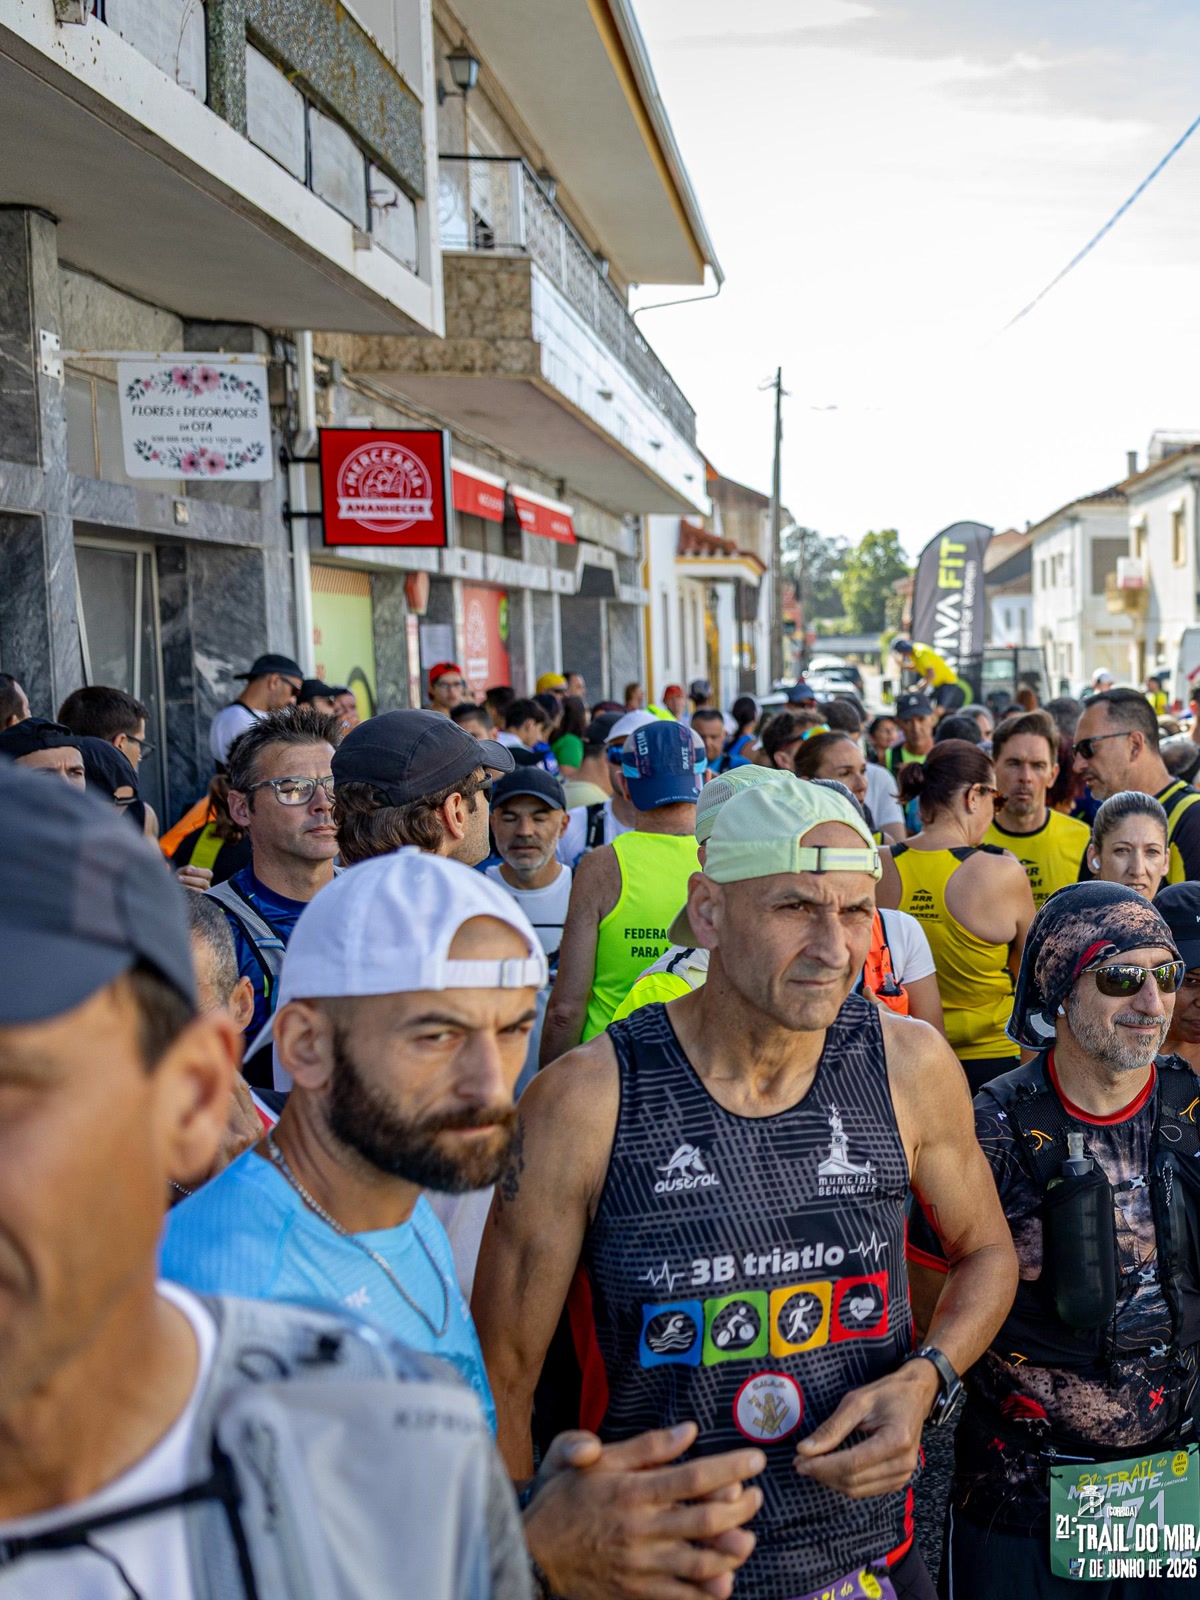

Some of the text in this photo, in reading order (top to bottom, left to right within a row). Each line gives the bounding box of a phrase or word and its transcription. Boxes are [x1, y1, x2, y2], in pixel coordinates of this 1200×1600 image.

[131, 405, 174, 417] FLORES
[191, 421, 213, 432] OTA
[345, 449, 423, 488] MERCEARIA
[347, 503, 425, 513] AMANHECER
[681, 746, 690, 770] SKATE
[624, 928, 669, 939] FEDERA
[631, 946, 660, 957] PARA
[654, 1172, 719, 1193] austral
[690, 1243, 844, 1286] 3B triatlo
[1157, 1457, 1168, 1468] do
[841, 1582, 854, 1596] do
